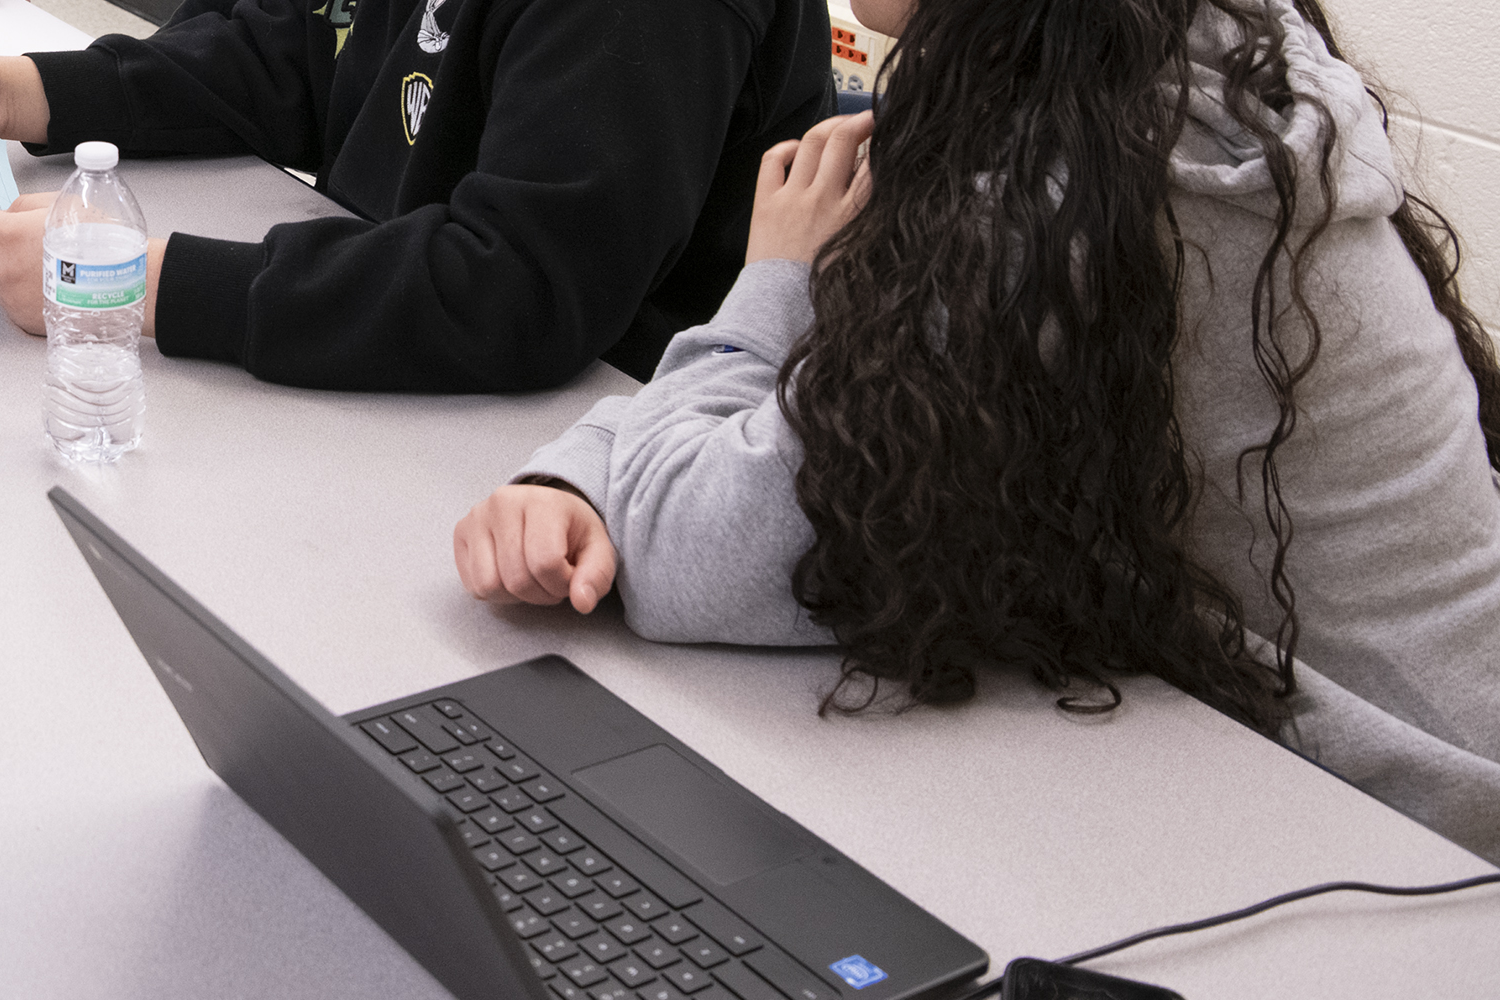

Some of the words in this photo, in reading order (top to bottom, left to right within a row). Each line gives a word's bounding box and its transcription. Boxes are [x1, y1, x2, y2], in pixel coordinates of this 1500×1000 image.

[80, 270, 116, 278] PURIFIED
[116, 264, 137, 276] WATER
[92, 291, 125, 300] RECYCLE
